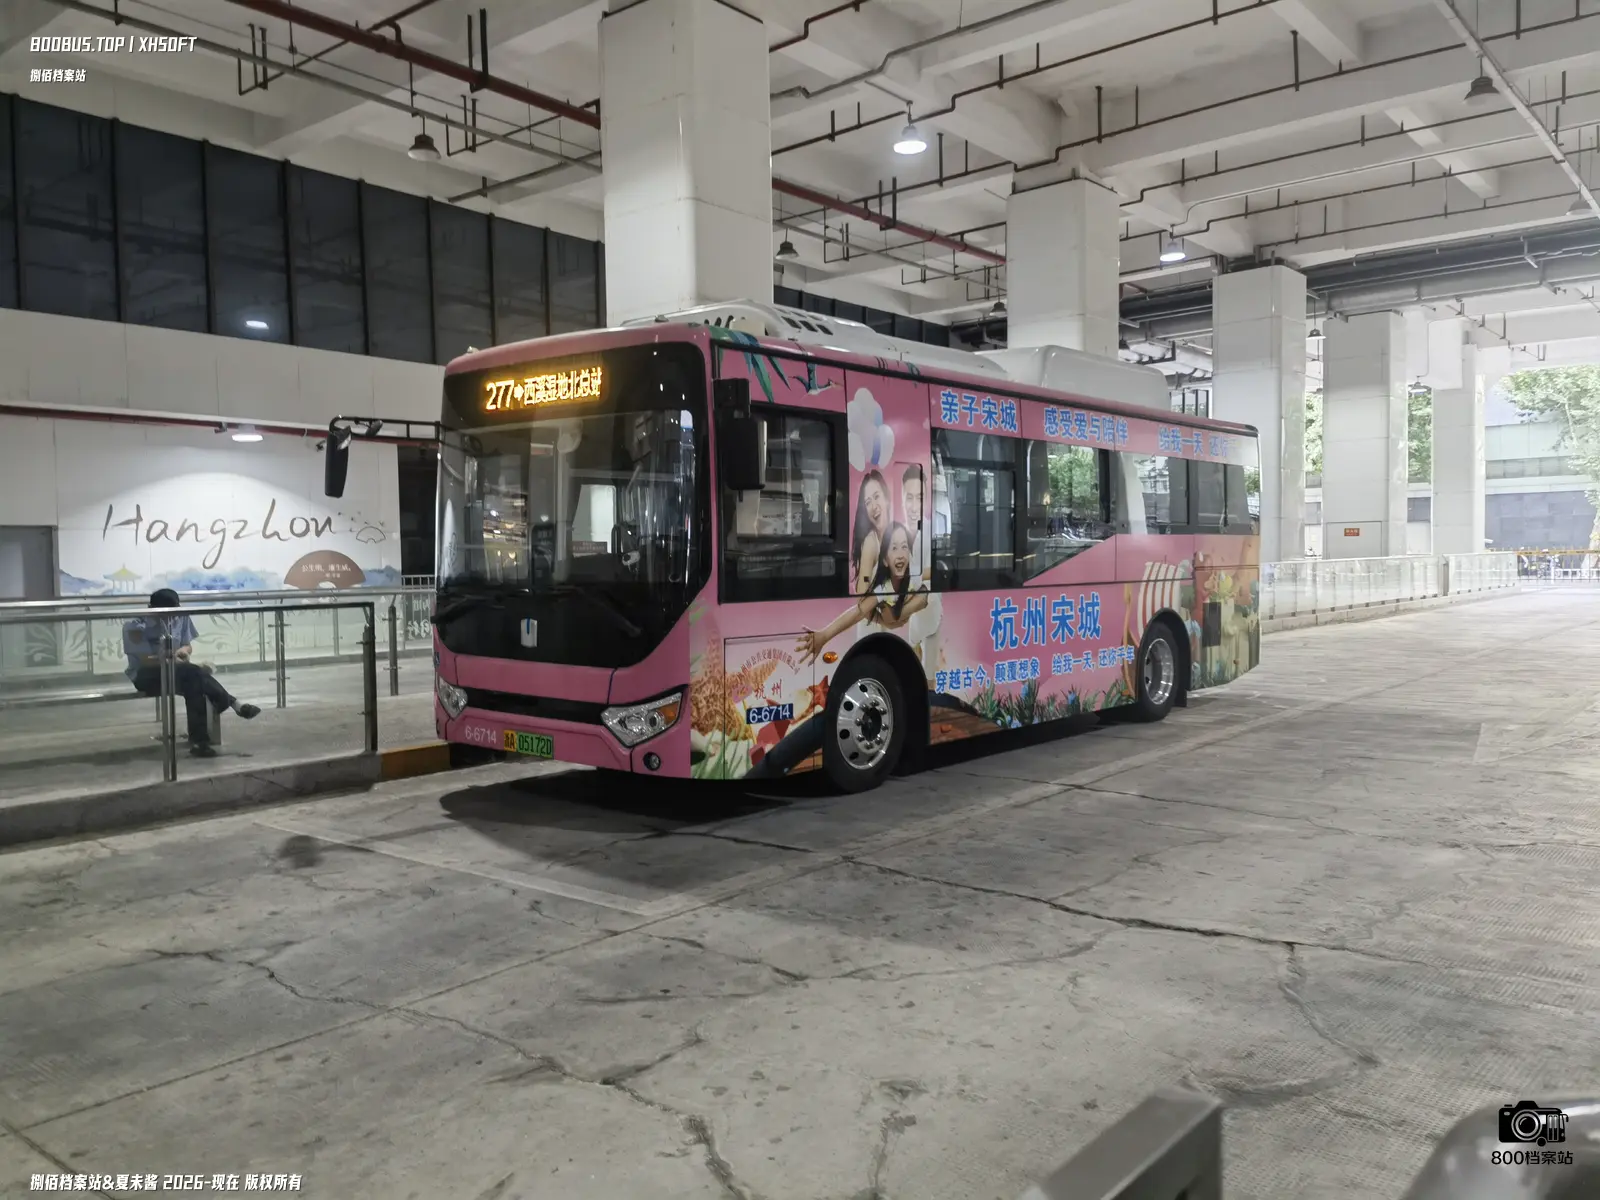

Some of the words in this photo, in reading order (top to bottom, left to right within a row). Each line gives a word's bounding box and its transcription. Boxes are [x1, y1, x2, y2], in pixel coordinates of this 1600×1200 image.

[486, 379, 515, 411] 277
[940, 390, 1018, 431] 亲子宋城
[1043, 407, 1129, 446] 感受爱与陪伴
[990, 592, 1103, 653] 杭州宋城
[935, 656, 1041, 694] 穿越古今，颠覆想象
[1051, 645, 1135, 676] 给我一天，还你千年
[749, 704, 791, 724] 6-6714
[464, 725, 497, 744] 6-6714
